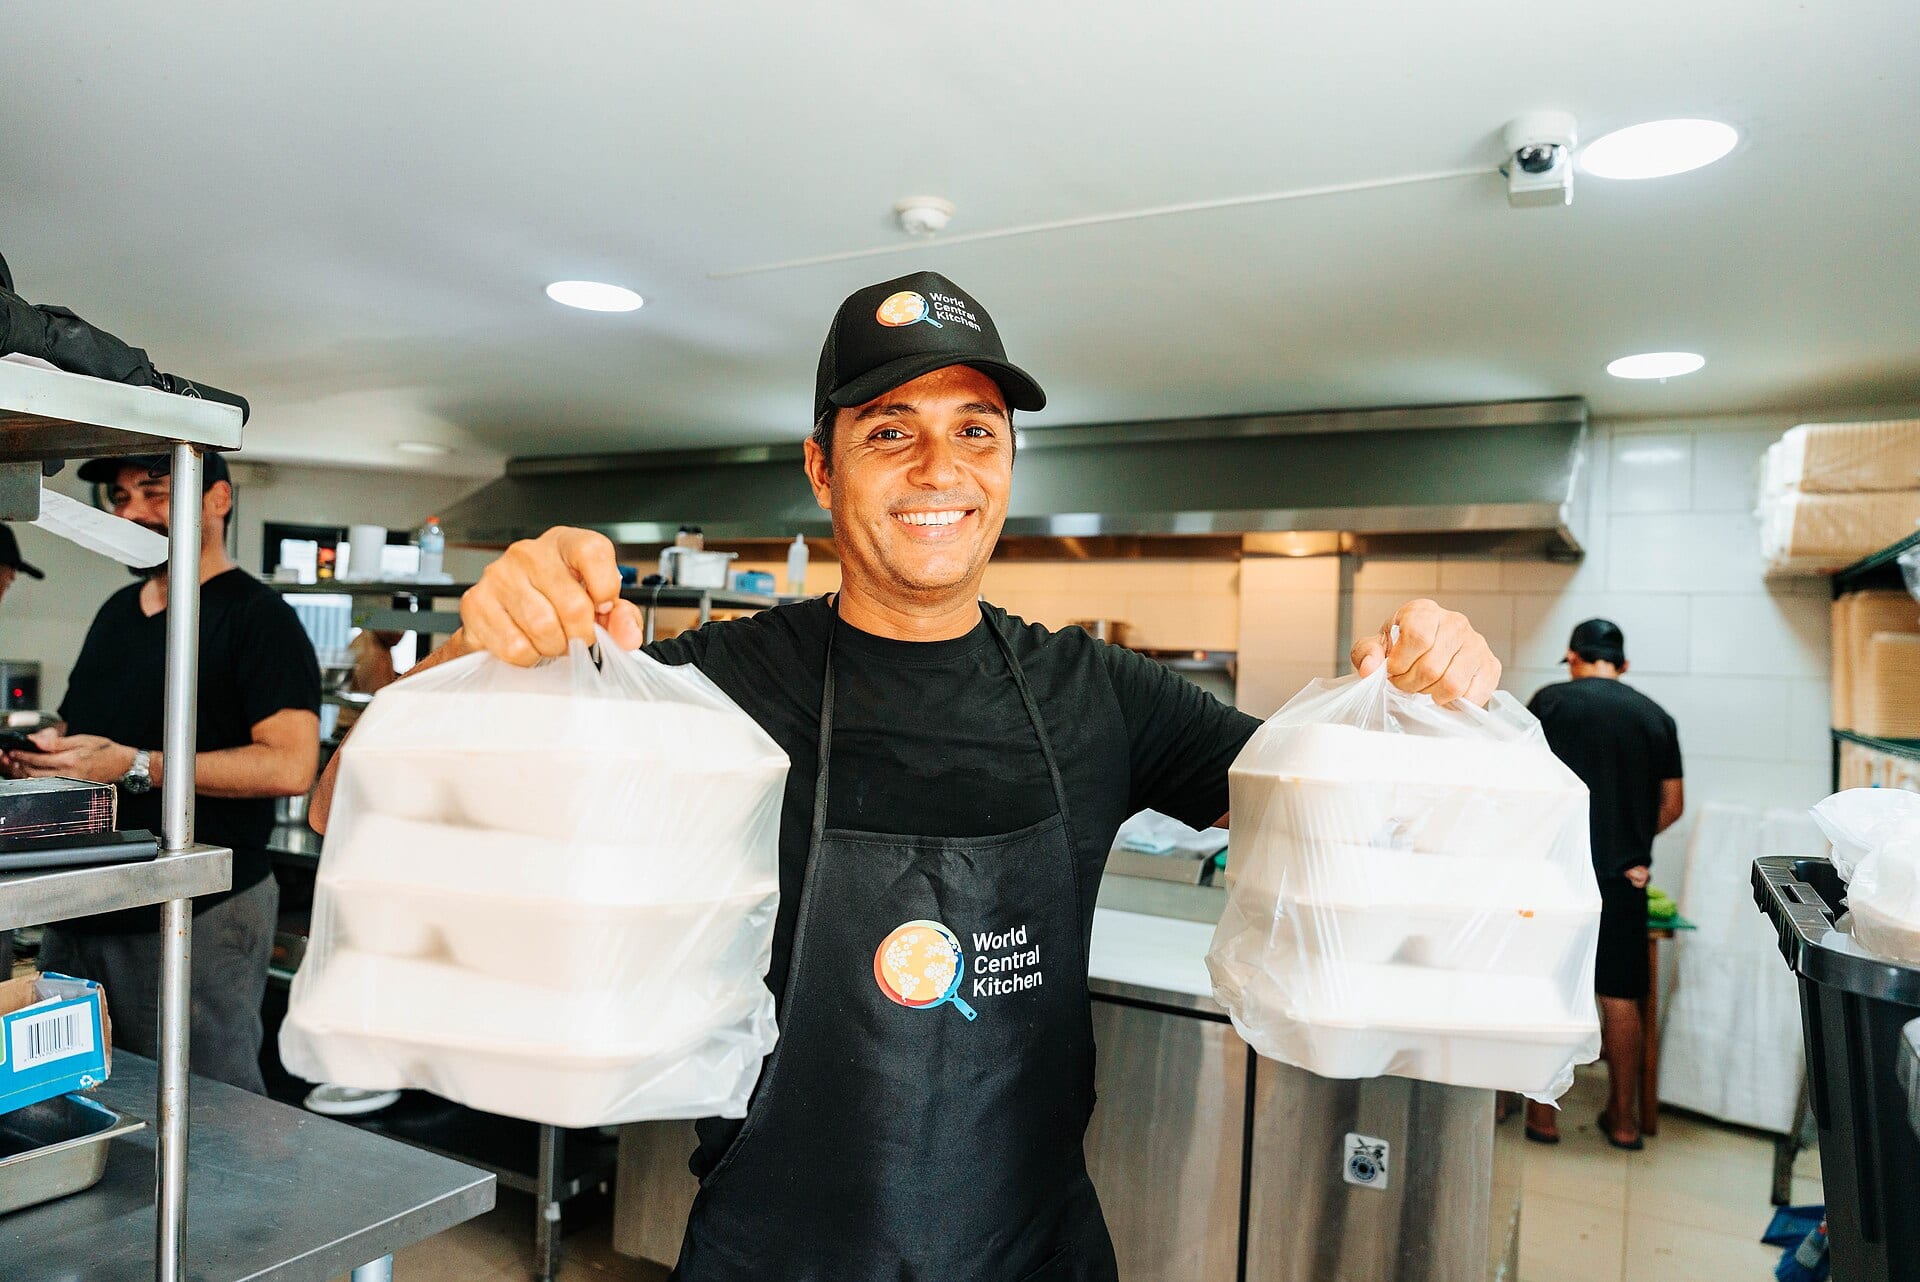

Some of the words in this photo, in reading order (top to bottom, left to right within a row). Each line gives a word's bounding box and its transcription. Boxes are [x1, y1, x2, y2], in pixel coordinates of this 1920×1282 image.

[929, 292, 965, 309] World
[933, 301, 976, 322] Central
[936, 310, 981, 332] Kitchen
[972, 924, 1028, 952] World
[974, 945, 1040, 975] Central
[973, 970, 1043, 997] Kitchen
